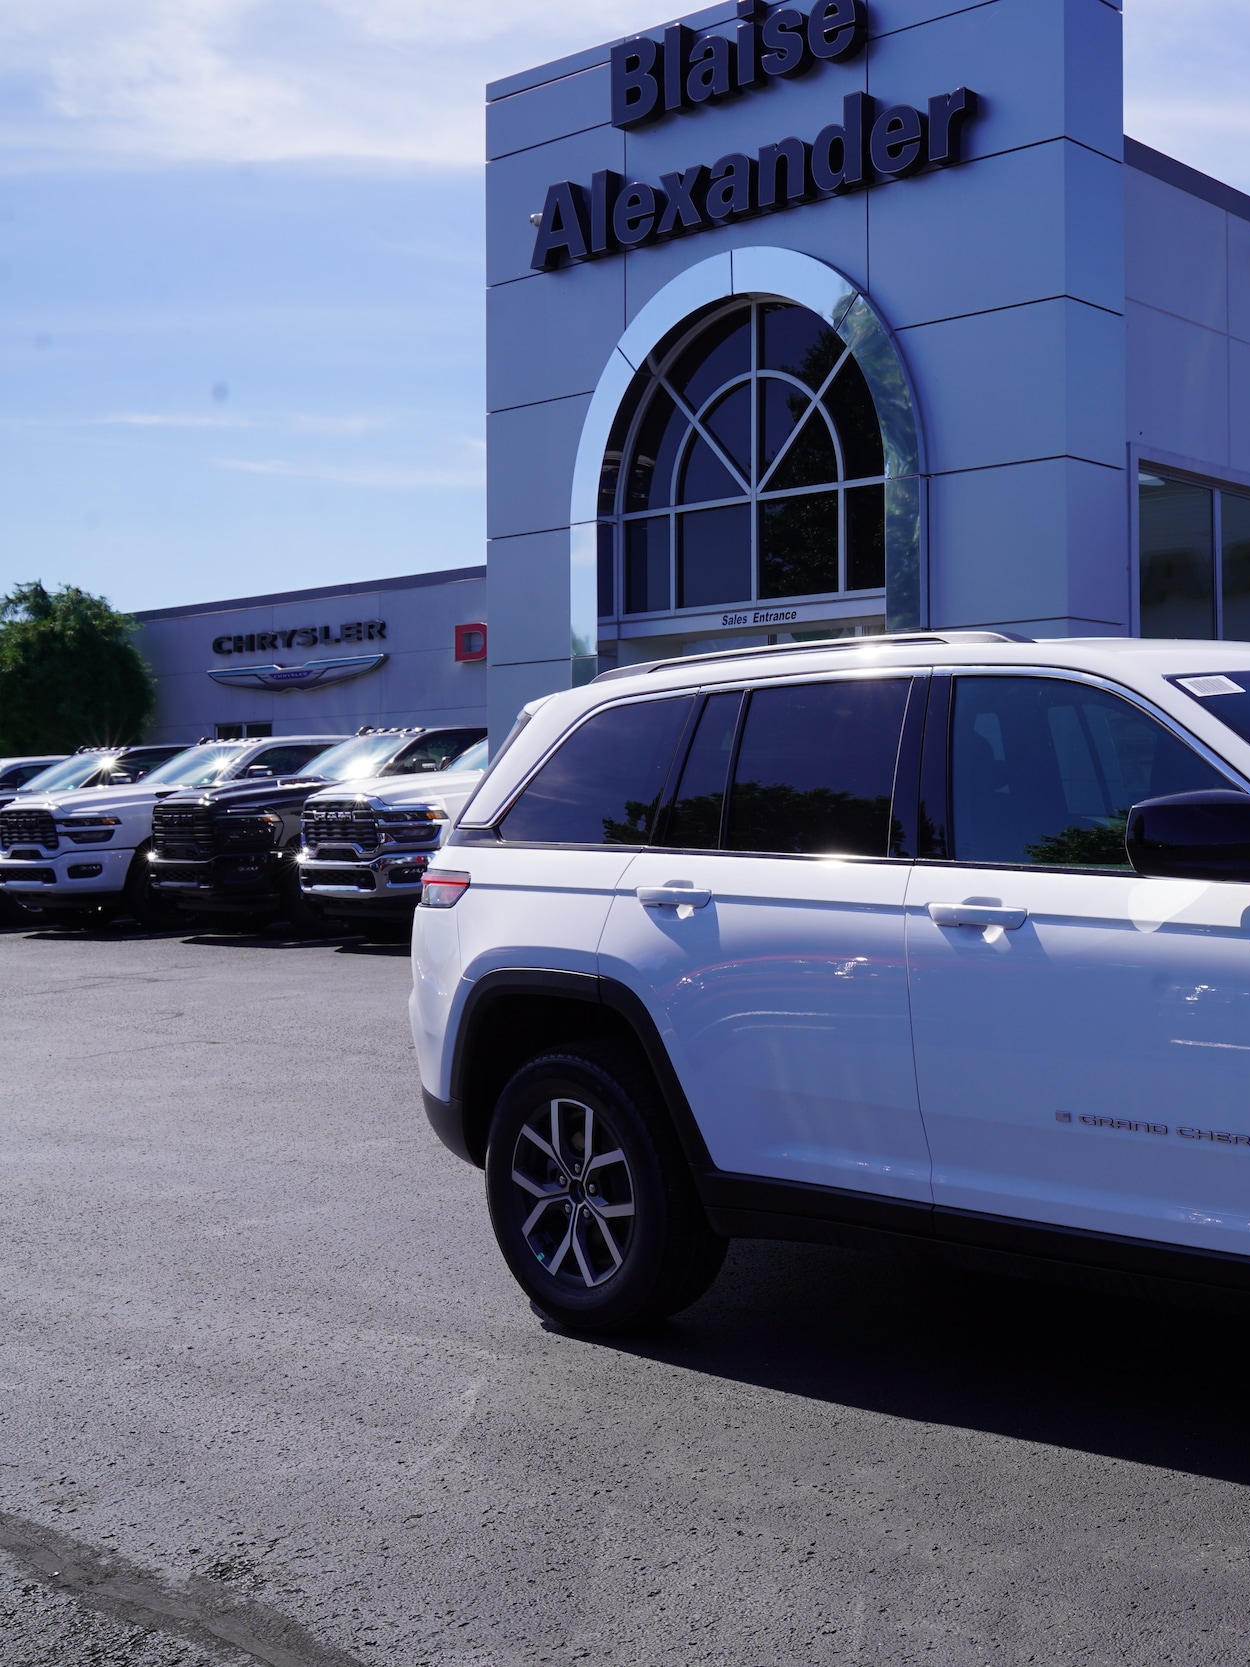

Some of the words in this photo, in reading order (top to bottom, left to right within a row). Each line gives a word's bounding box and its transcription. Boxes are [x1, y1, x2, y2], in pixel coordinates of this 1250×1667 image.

[610, 0, 867, 129] Blaise
[530, 88, 977, 270] Alexander
[722, 613, 748, 626] Sales
[753, 610, 797, 624] Entrance
[212, 619, 387, 655] CHRYSLER
[273, 671, 308, 679] CHRYSLER
[1078, 1113, 1168, 1136] GRAND
